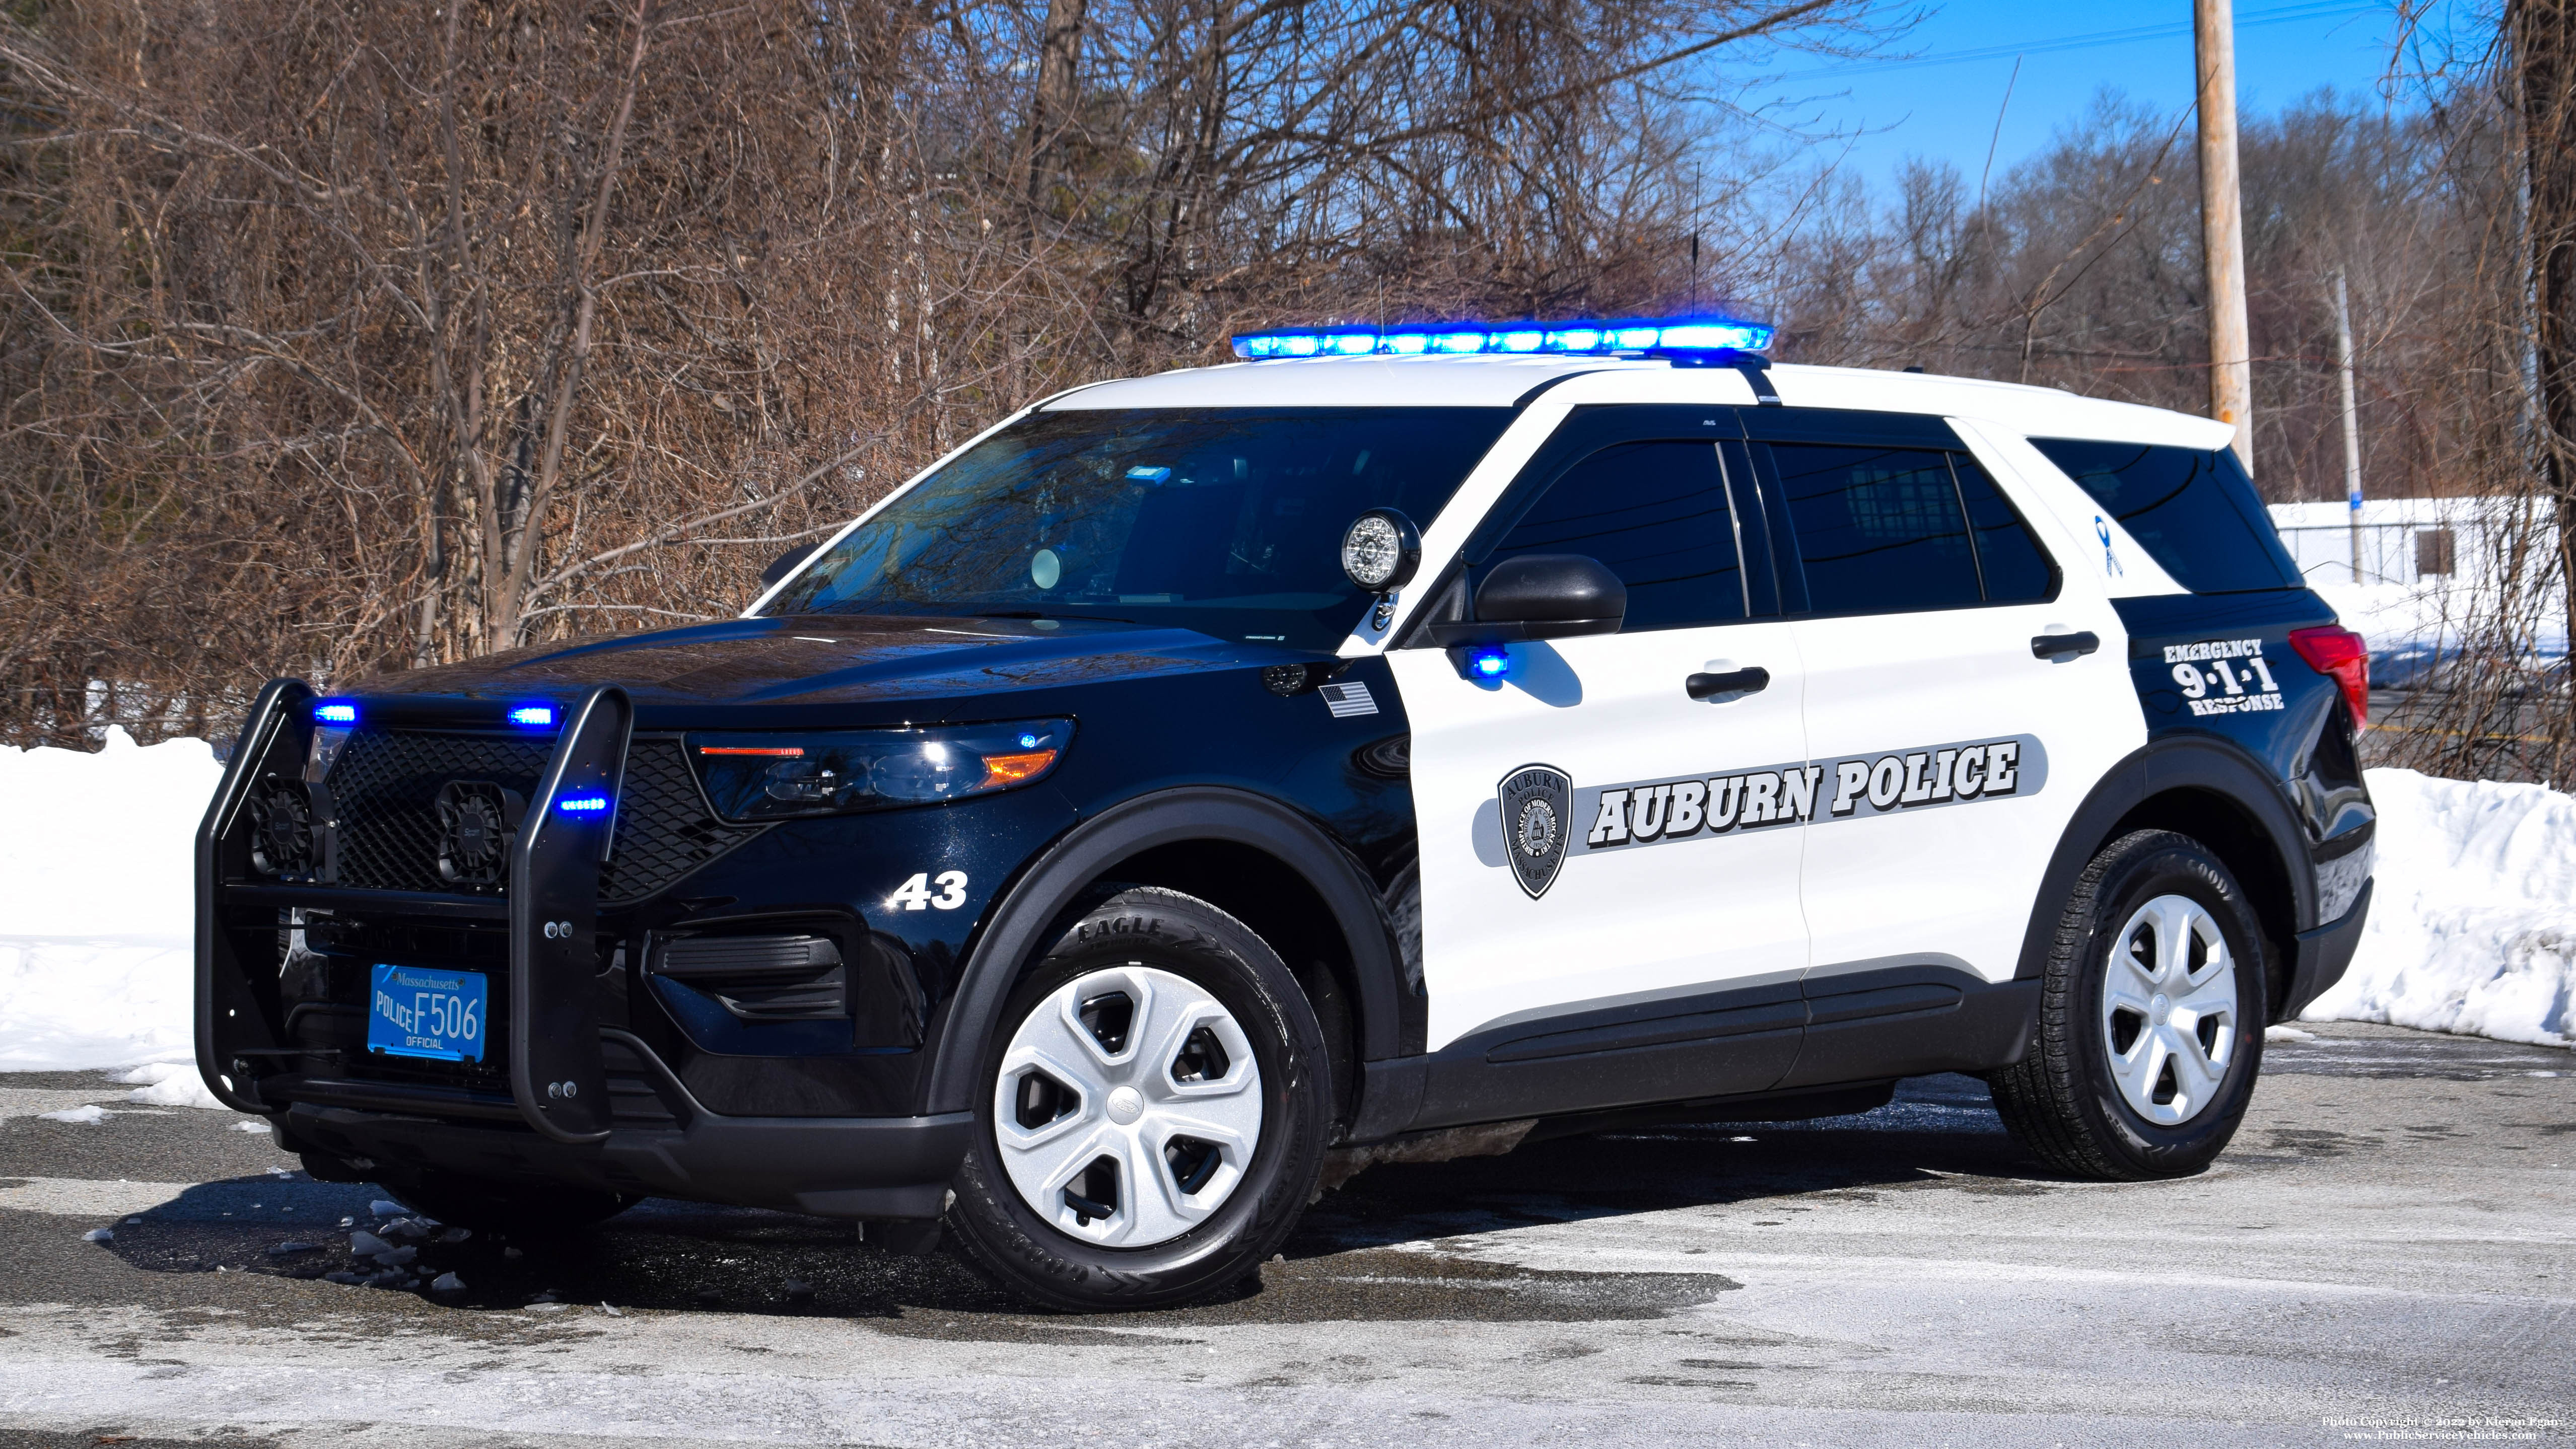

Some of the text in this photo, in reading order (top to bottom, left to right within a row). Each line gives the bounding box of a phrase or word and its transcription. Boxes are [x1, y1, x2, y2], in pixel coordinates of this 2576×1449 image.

[2164, 639, 2263, 664] EMERGENCY
[2188, 693, 2284, 716] RESPONSE
[1507, 772, 1563, 801] AUBURN
[1518, 788, 1554, 806] POLICE
[1587, 741, 2021, 849] AUBURN POLICE
[1518, 799, 1557, 856] BIRTHPLACE OF MODERN ROCKETRY
[1511, 833, 1564, 881] MASSACHUSETTS
[893, 871, 968, 910] 43
[1077, 915, 1164, 943] EAGLE
[396, 972, 459, 990] Massachusetts
[376, 990, 477, 1040] POLICE F506
[406, 1036, 443, 1050] OFFICIAL
